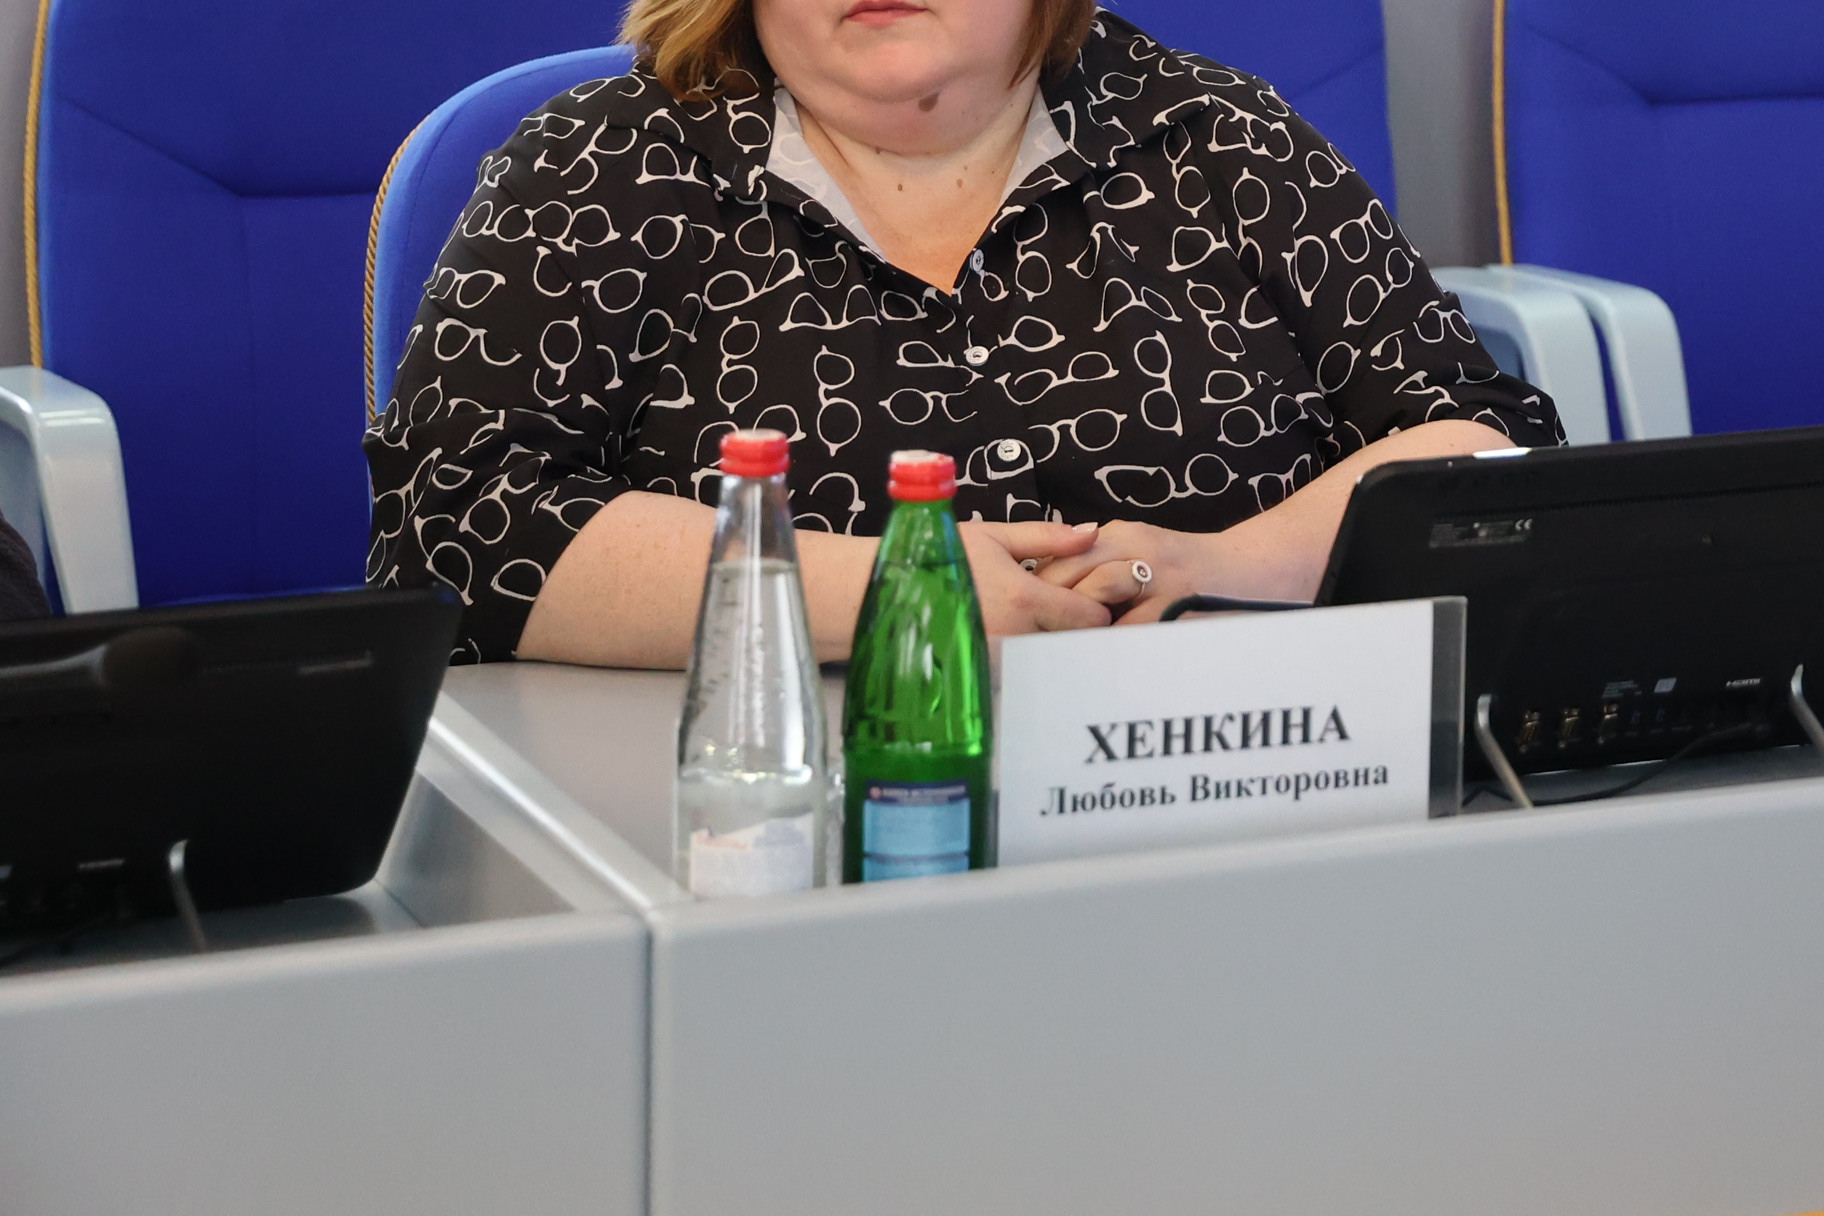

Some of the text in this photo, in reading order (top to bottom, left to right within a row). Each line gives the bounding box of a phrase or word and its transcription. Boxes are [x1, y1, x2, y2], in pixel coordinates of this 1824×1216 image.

[1084, 704, 1352, 764] ХЕНКИНА
[1039, 765, 1389, 816] Любовь Викторовна
